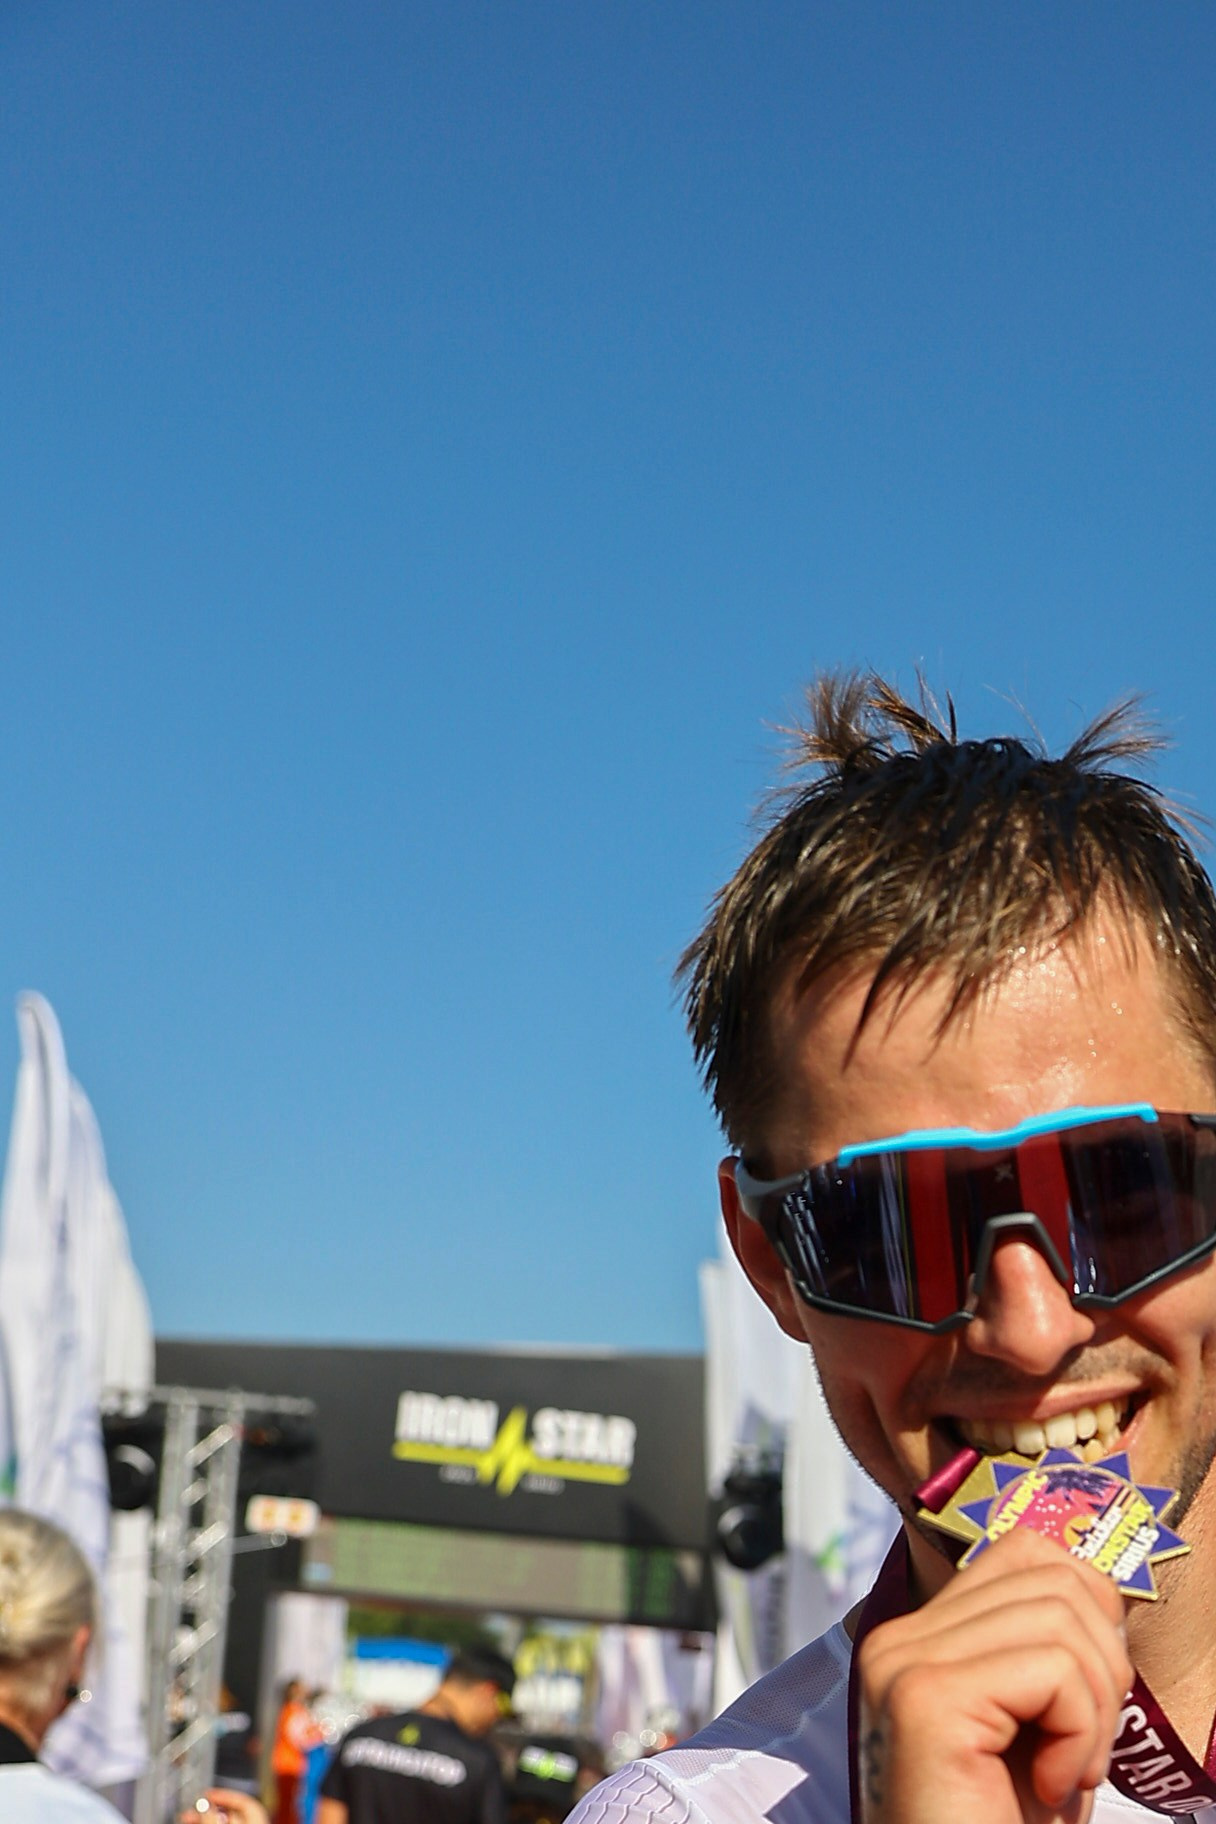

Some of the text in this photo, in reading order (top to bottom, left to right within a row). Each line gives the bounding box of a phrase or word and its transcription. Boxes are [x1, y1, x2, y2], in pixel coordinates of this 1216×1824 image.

[395, 1389, 637, 1467] IRON STAR
[1111, 1526, 1160, 1582] SIRIUS
